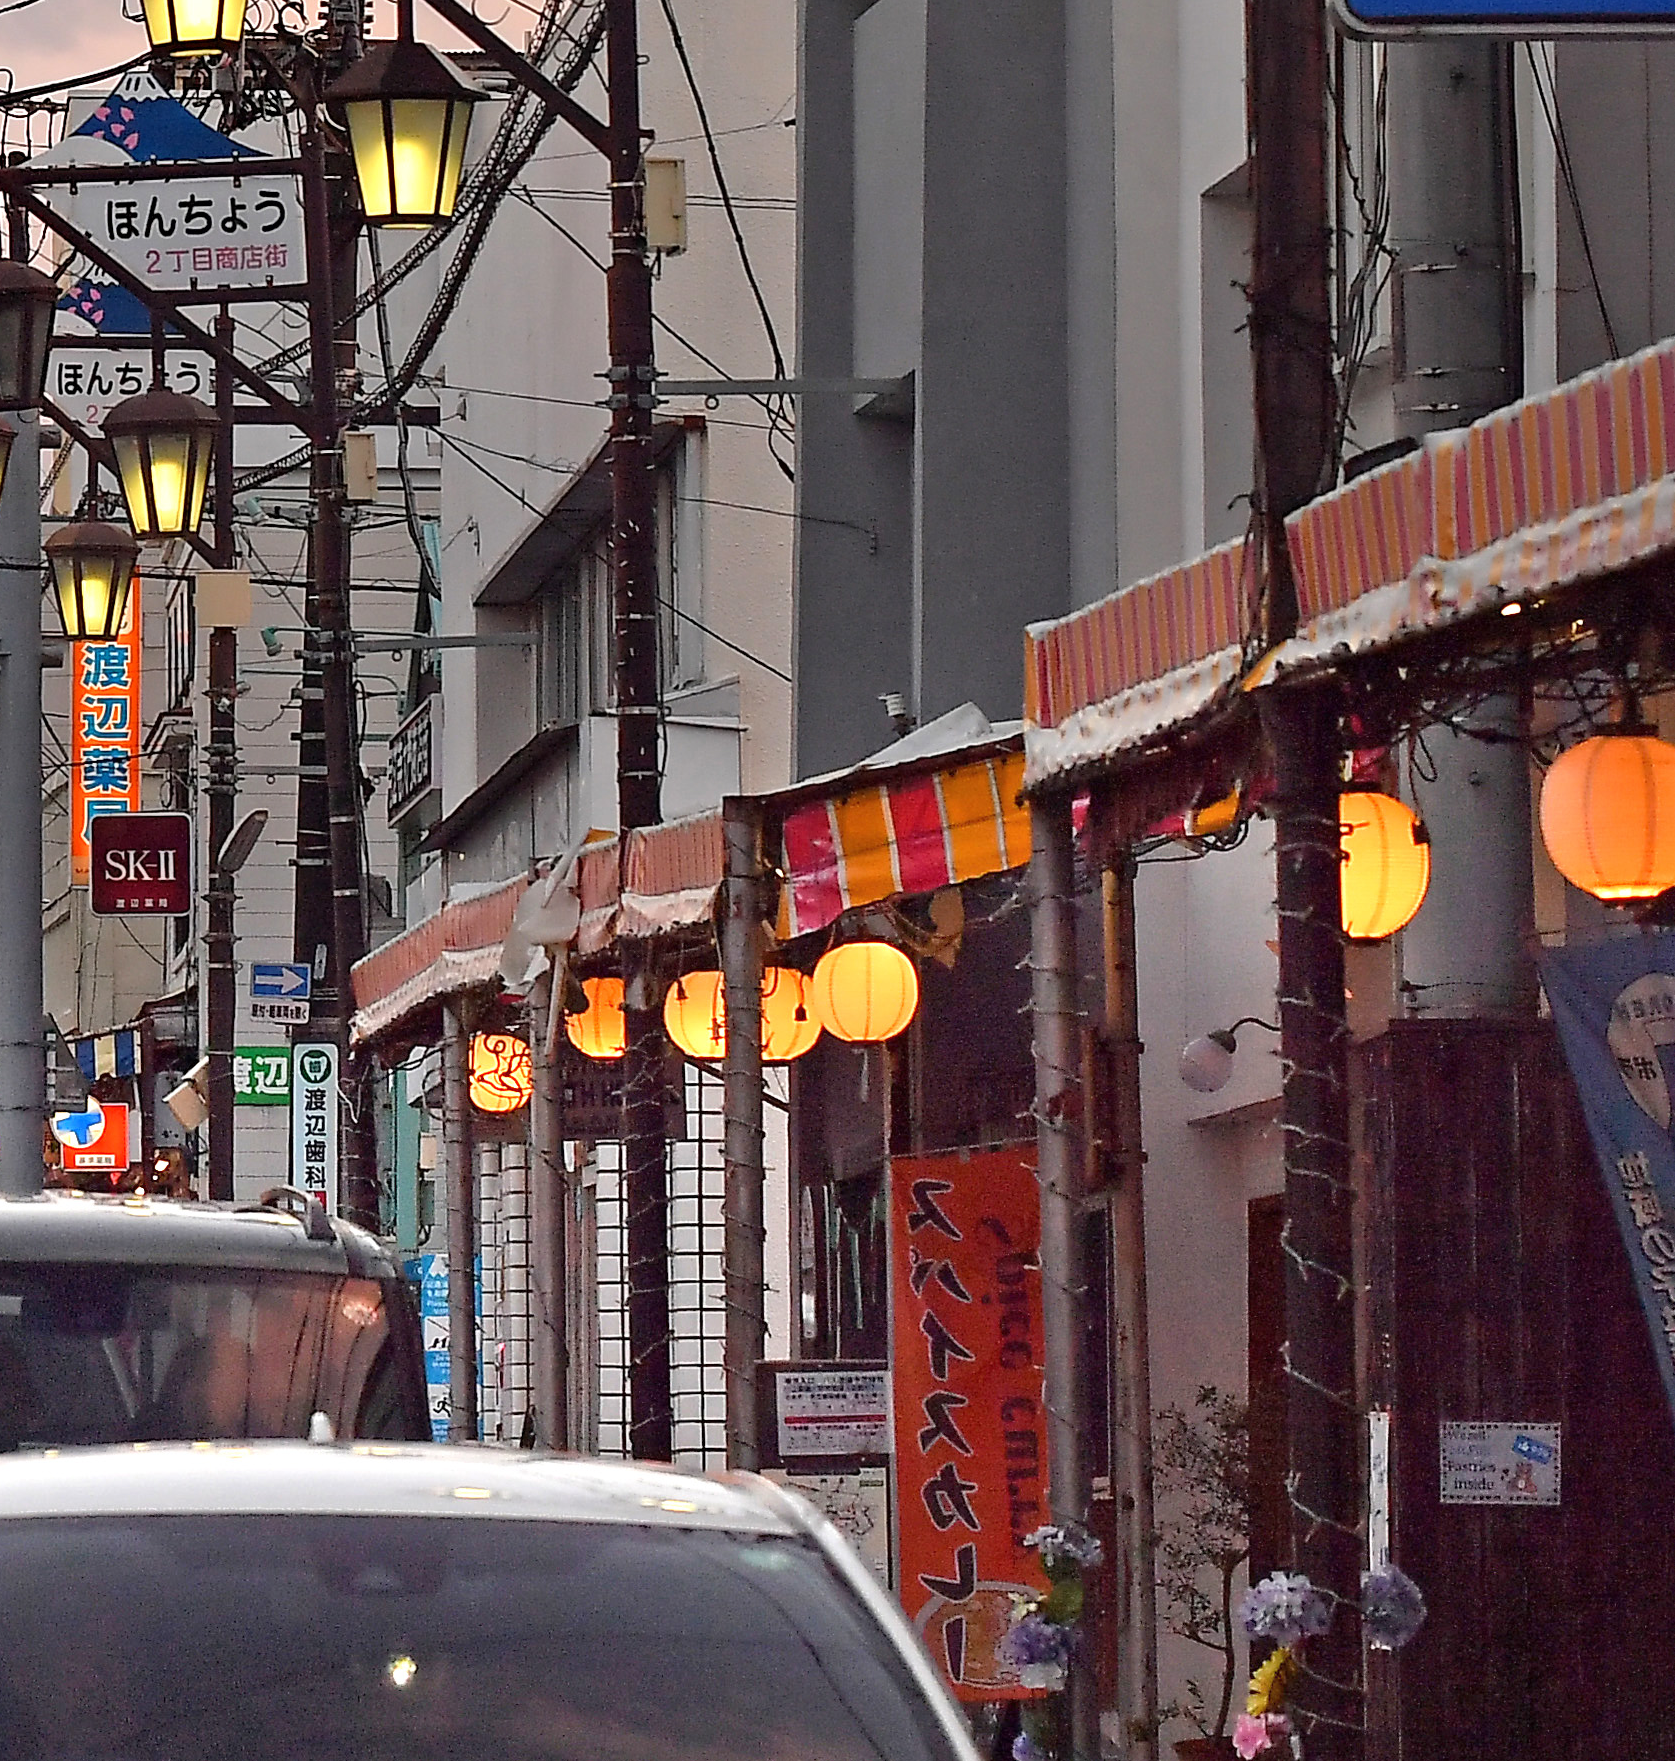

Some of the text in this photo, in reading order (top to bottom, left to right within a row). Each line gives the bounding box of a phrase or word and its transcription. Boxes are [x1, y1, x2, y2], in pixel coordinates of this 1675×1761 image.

[106, 189, 288, 240] ほんちょう
[145, 245, 289, 272] 2丁目商店街
[57, 360, 202, 396] ほんちう
[303, 1088, 327, 1189] 渡辺歯科
